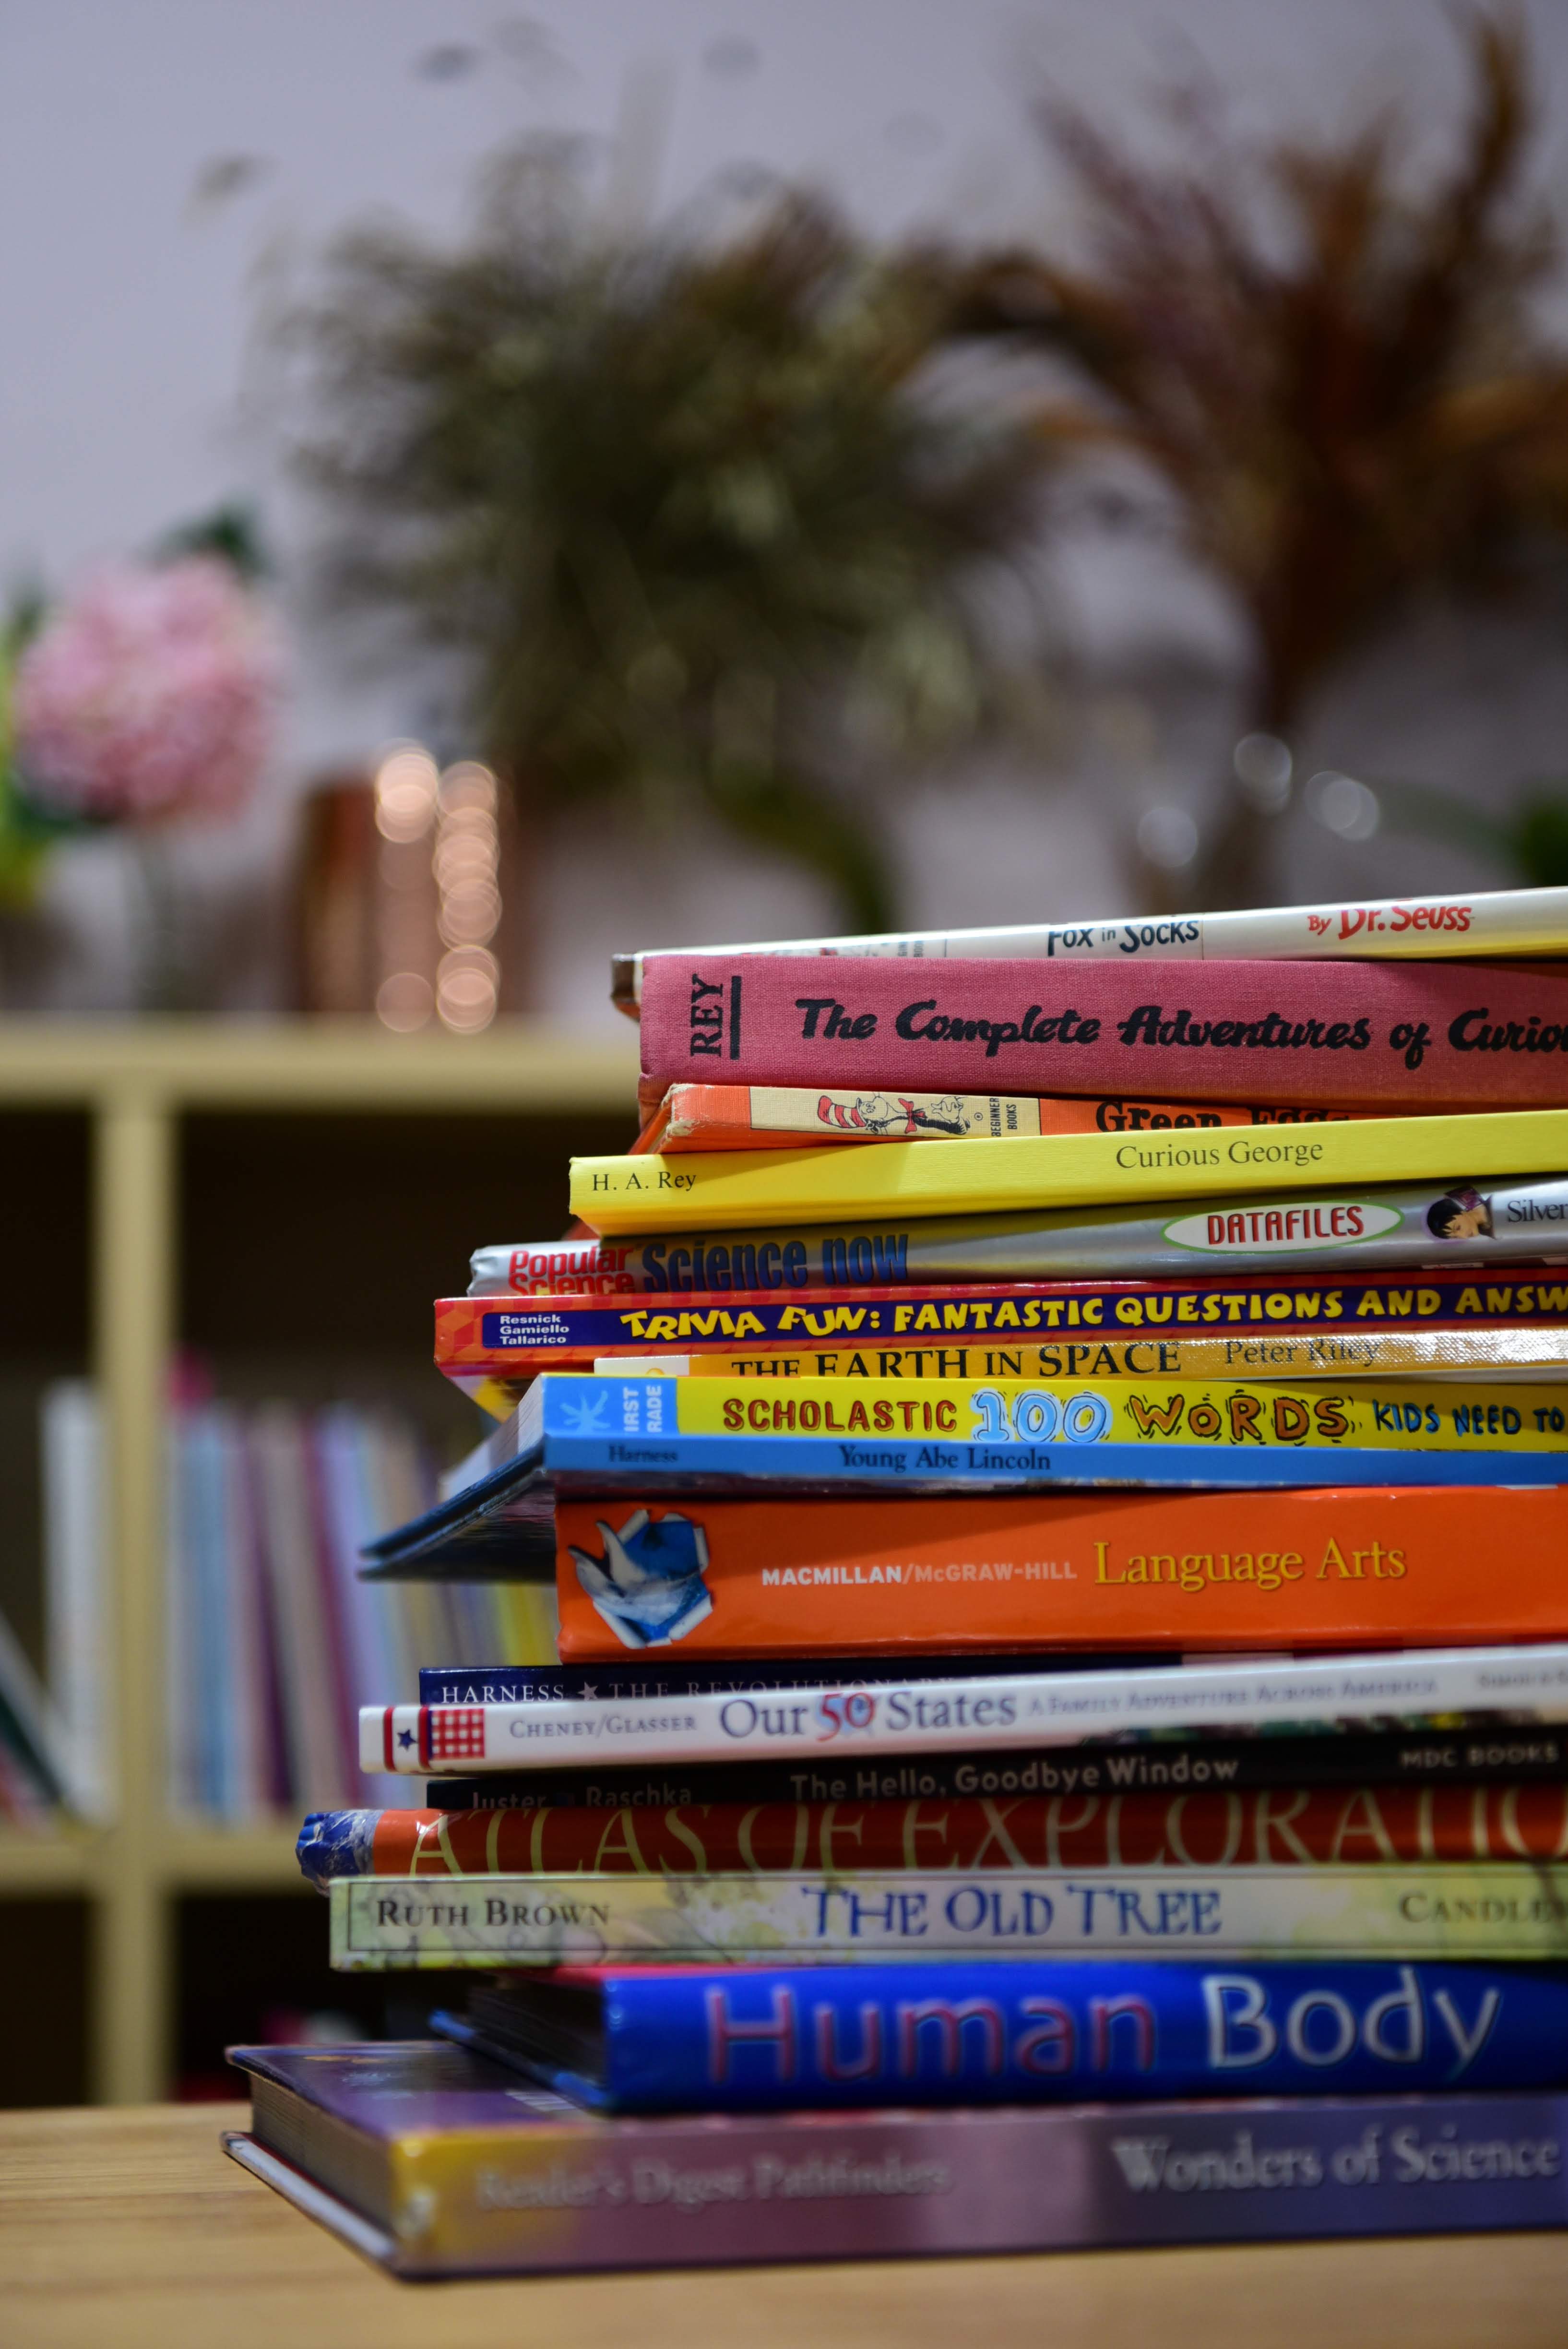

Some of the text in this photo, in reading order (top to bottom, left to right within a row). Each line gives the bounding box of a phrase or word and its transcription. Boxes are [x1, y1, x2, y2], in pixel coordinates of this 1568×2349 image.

[1102, 927, 1117, 942] in
[1307, 906, 1472, 940] By Dr. Seuss
[690, 973, 724, 1057] REY
[795, 998, 876, 1039] The
[896, 999, 1101, 1057] Complete
[1117, 1005, 1371, 1049] Adventures
[1389, 1019, 1431, 1070] of
[989, 1097, 1001, 1137] BEGINNER
[1006, 1104, 1018, 1130] BOOKS
[1096, 1101, 1222, 1133] Green
[1116, 1140, 1323, 1169] Curious George
[592, 1170, 697, 1192] H. A. Rey
[1207, 1205, 1364, 1246] DATAFILES
[509, 1246, 634, 1283] Popular
[641, 1234, 909, 1294] Science now
[509, 1273, 635, 1295] Science
[500, 1314, 561, 1324] Resnick
[500, 1324, 569, 1335] Gamiello
[620, 1311, 765, 1341] TRIVIA
[777, 1306, 881, 1337] FUN:
[893, 1298, 1103, 1333] FANTASTIC
[1115, 1289, 1343, 1327] QUESTIONS
[1356, 1289, 1442, 1317] AND
[499, 1335, 566, 1345] Tallarico
[1226, 1341, 1297, 1364] Peter
[732, 1342, 1181, 1378] THE EARTH IN SPACE
[723, 1398, 957, 1432] SCHOLASTIC
[970, 1387, 1114, 1444] 100
[1372, 1399, 1441, 1433] KIDS
[1453, 1405, 1521, 1437] NEED
[1533, 1406, 1565, 1433] TO
[609, 1445, 677, 1463] Harness
[839, 1445, 1051, 1472] Young Abe Lincoln
[1094, 1538, 1407, 1593] Language Arts
[442, 1684, 565, 1704] HARNESS
[609, 1683, 669, 1701] THE
[721, 1691, 1017, 1742] Our 50 States
[1400, 1742, 1559, 1770] MDC BOOKS
[791, 1753, 1238, 1801] The Hello, Goodbye Window
[586, 1781, 691, 1807] Raschka
[377, 1899, 610, 1927] RUTH BROWN
[801, 1883, 1223, 1937] THE OLD TREE
[706, 1965, 1500, 2085] Human Body
[1112, 2123, 1562, 2192] Wonders of Science
